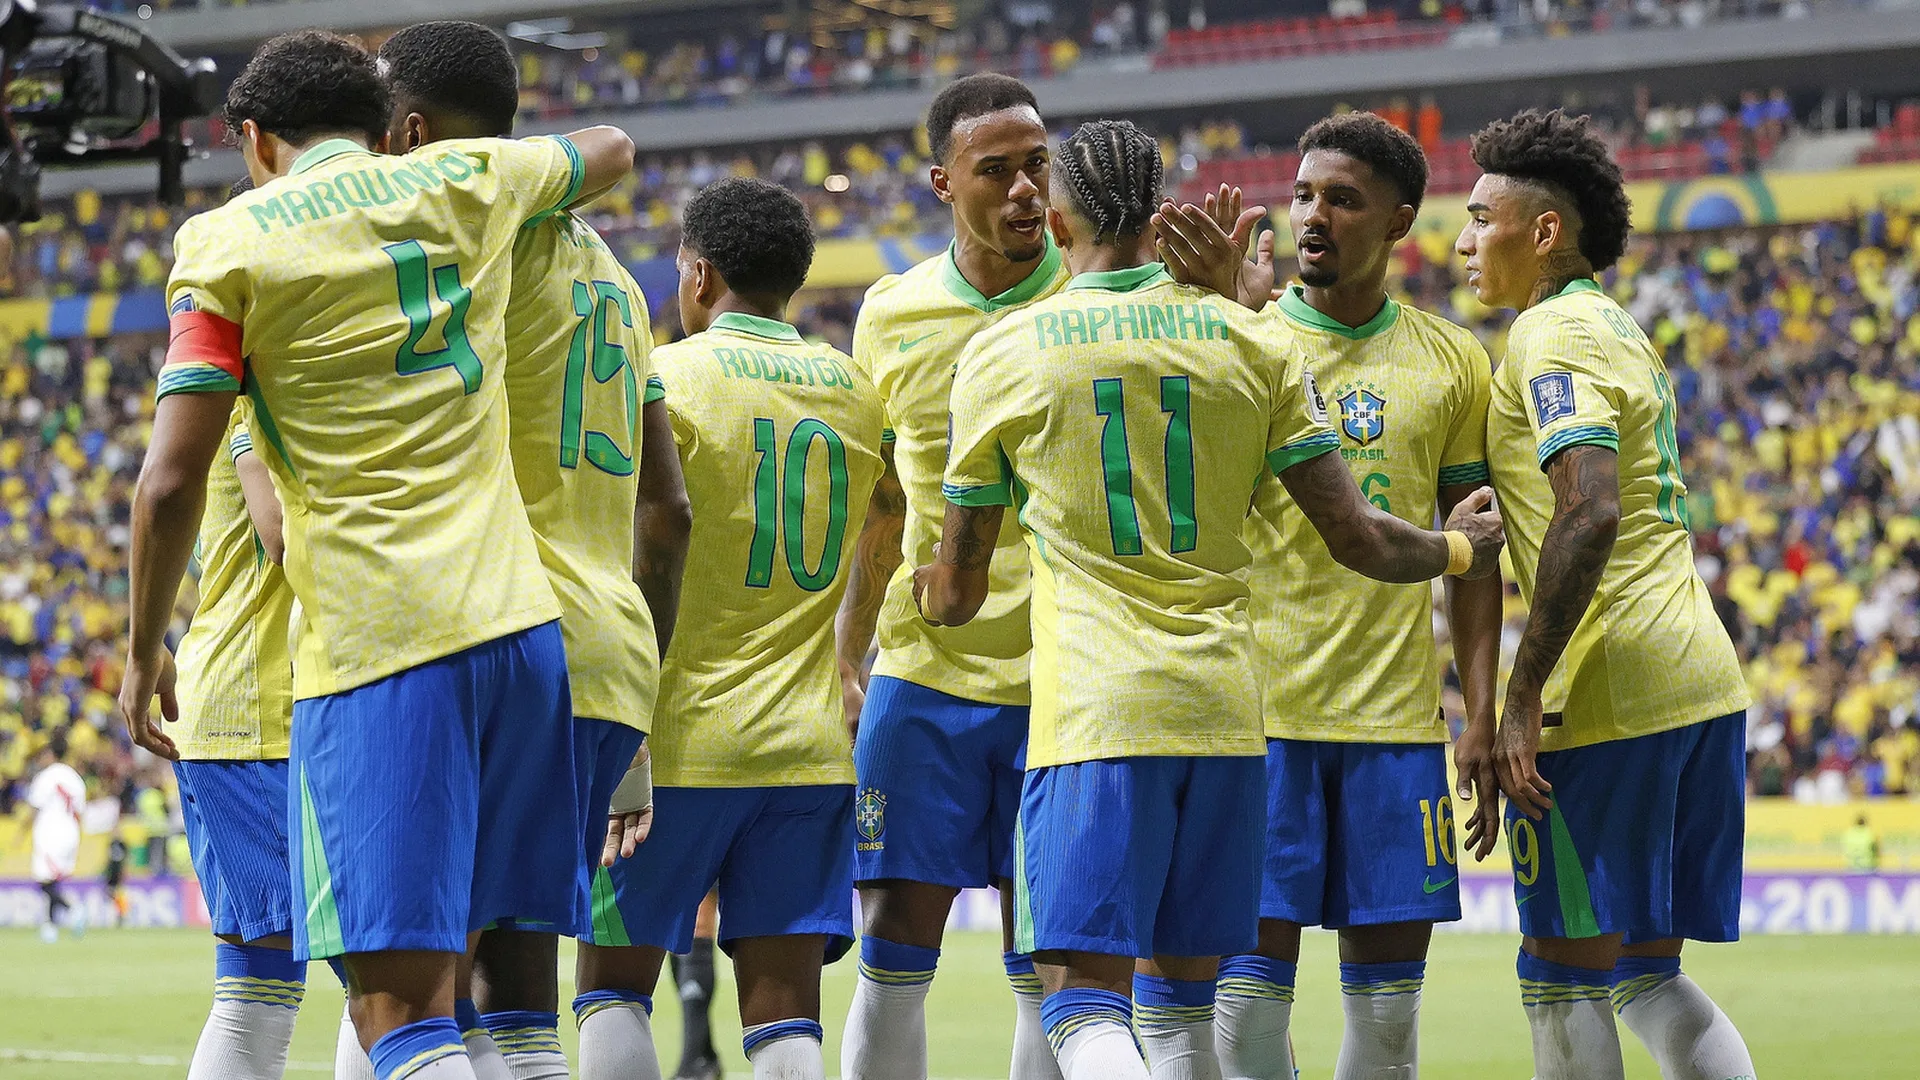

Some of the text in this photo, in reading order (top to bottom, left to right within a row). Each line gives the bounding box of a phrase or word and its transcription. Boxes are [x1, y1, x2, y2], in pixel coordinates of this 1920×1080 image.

[247, 150, 487, 233] MARQUNHOS
[381, 239, 483, 396] 4
[1034, 303, 1229, 350] RAPHINHA
[559, 278, 636, 476] 15
[713, 346, 854, 390] RODRYGO
[1353, 411, 1371, 420] CBF
[1093, 375, 1198, 556] 11
[1341, 448, 1388, 461] BRASIL
[744, 417, 849, 592] 10
[1361, 472, 1391, 514] 6
[857, 841, 885, 852] BRASIL
[1419, 796, 1456, 867] 16
